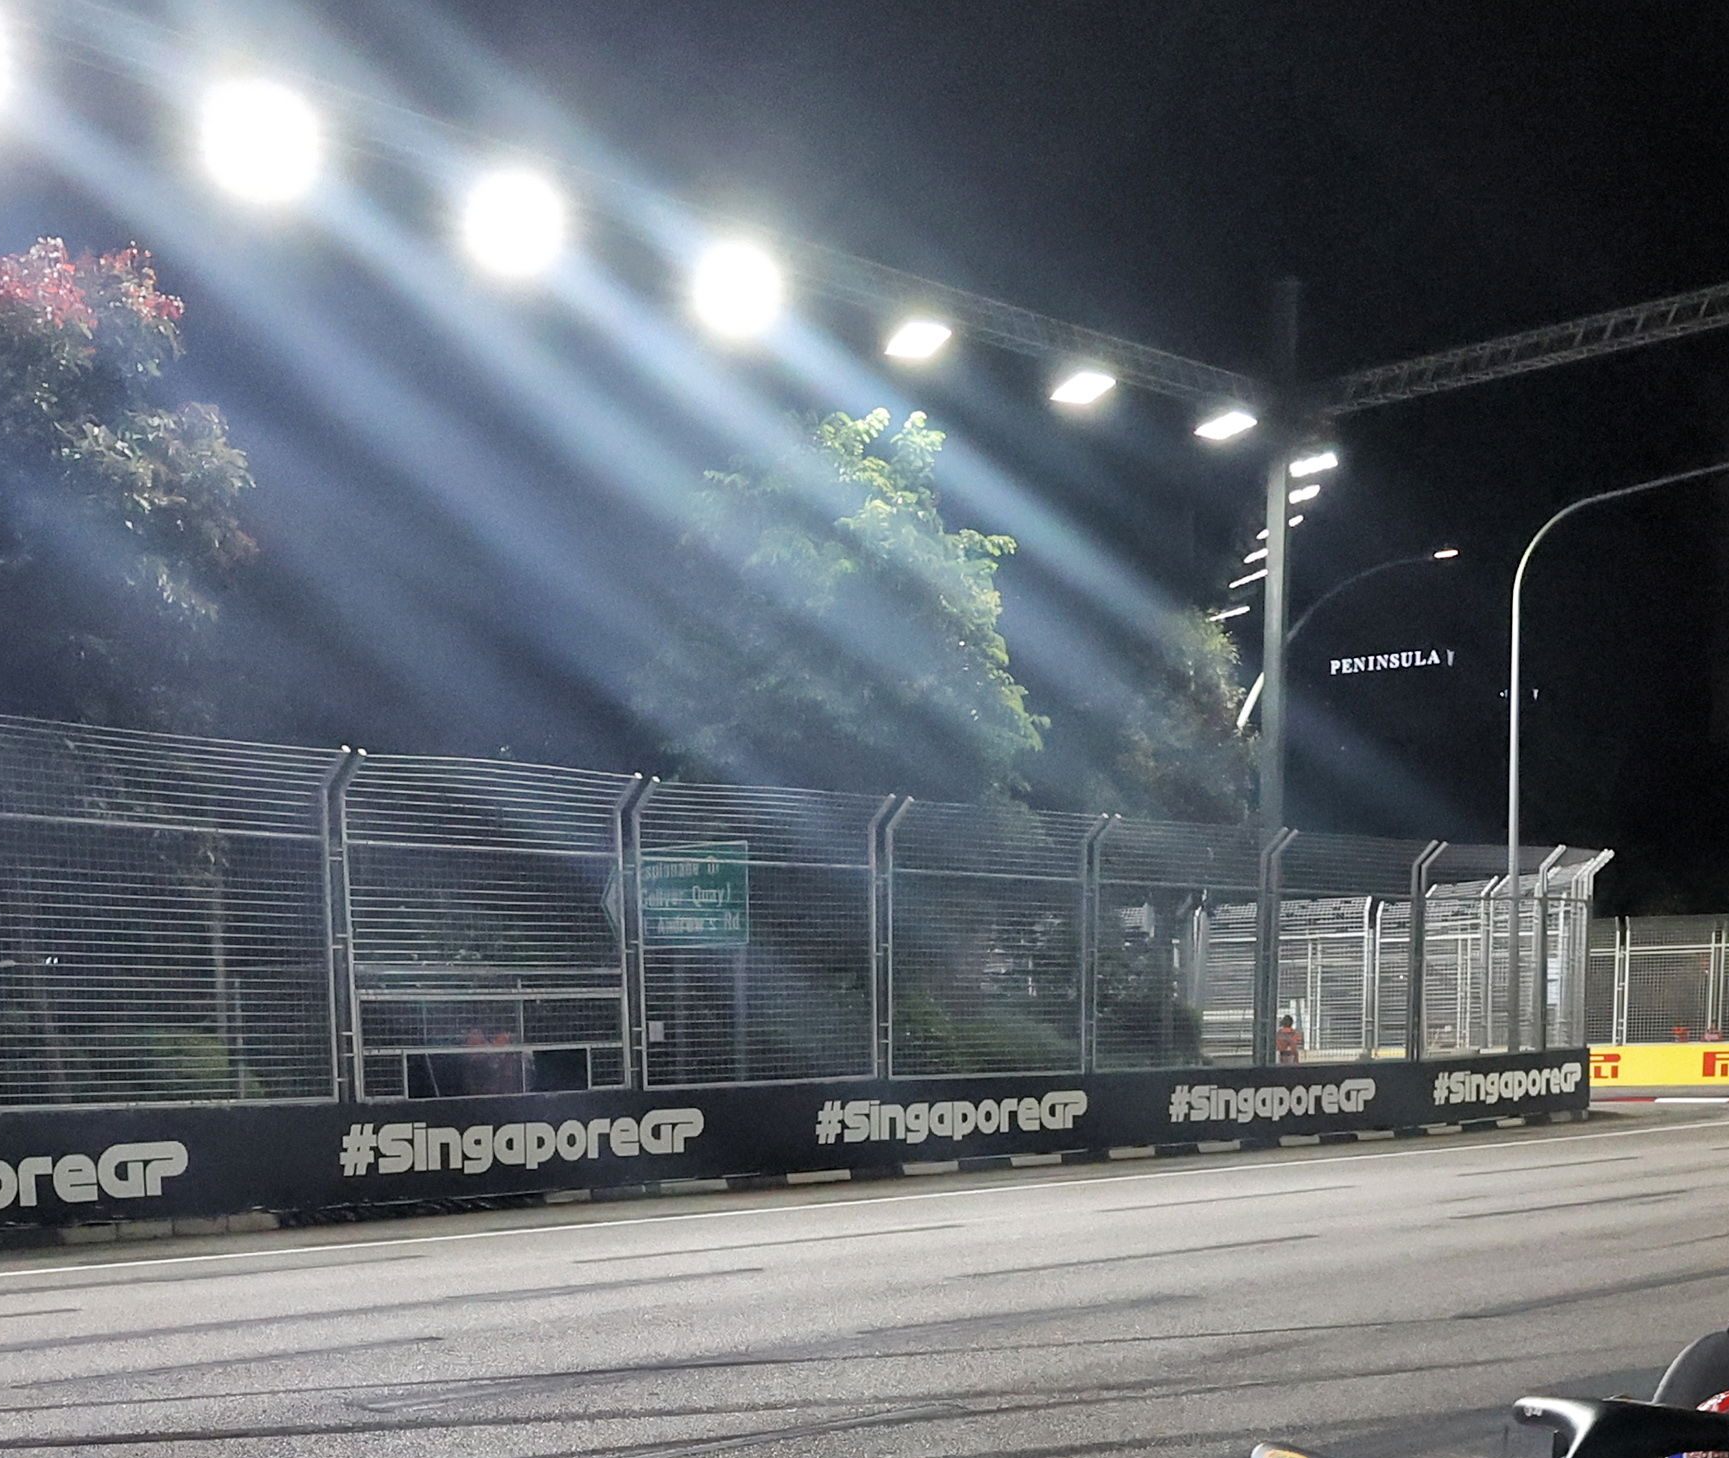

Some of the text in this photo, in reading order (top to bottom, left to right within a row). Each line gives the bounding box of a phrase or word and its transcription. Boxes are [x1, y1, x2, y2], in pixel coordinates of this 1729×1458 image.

[1330, 650, 1440, 675] PENINSULA
[643, 860, 700, 880] splanade
[725, 911, 740, 931] Rd
[1168, 1076, 1377, 1123] #SingaporeGP
[1433, 1061, 1582, 1106] #SingaporeGP
[815, 1089, 1087, 1145] #SingaporeGP
[338, 1107, 705, 1178] #SingaporeGP
